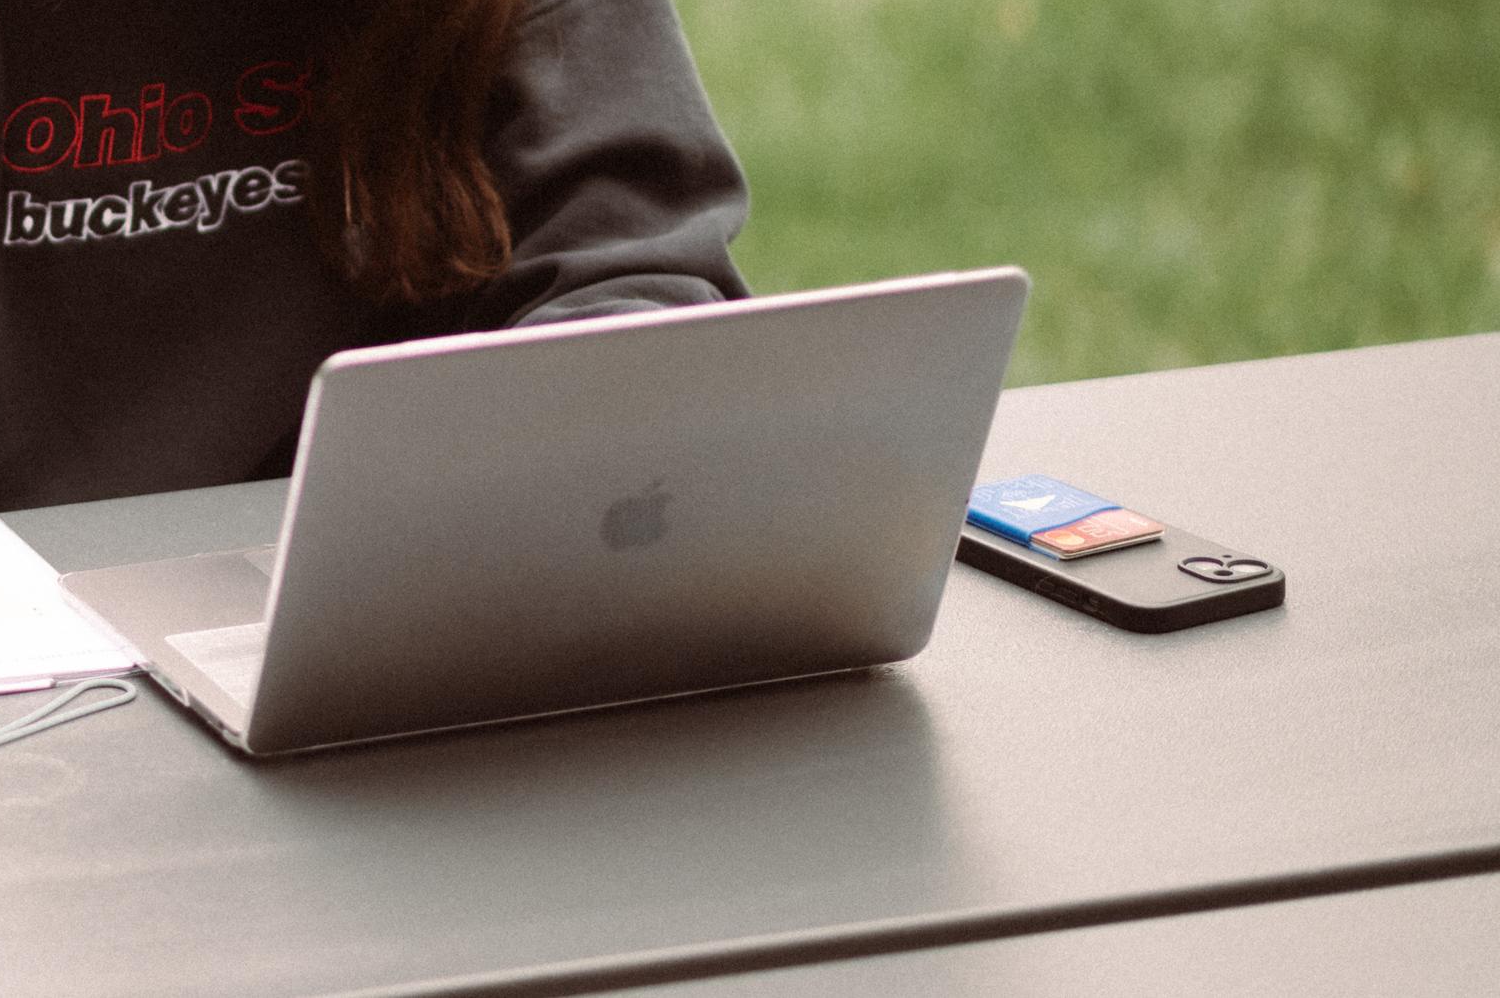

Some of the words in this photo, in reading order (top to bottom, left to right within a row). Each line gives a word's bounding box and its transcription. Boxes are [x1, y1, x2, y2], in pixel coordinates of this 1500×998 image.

[3, 83, 213, 173] Ohio
[235, 60, 313, 136] S
[3, 159, 309, 245] buckeyes
